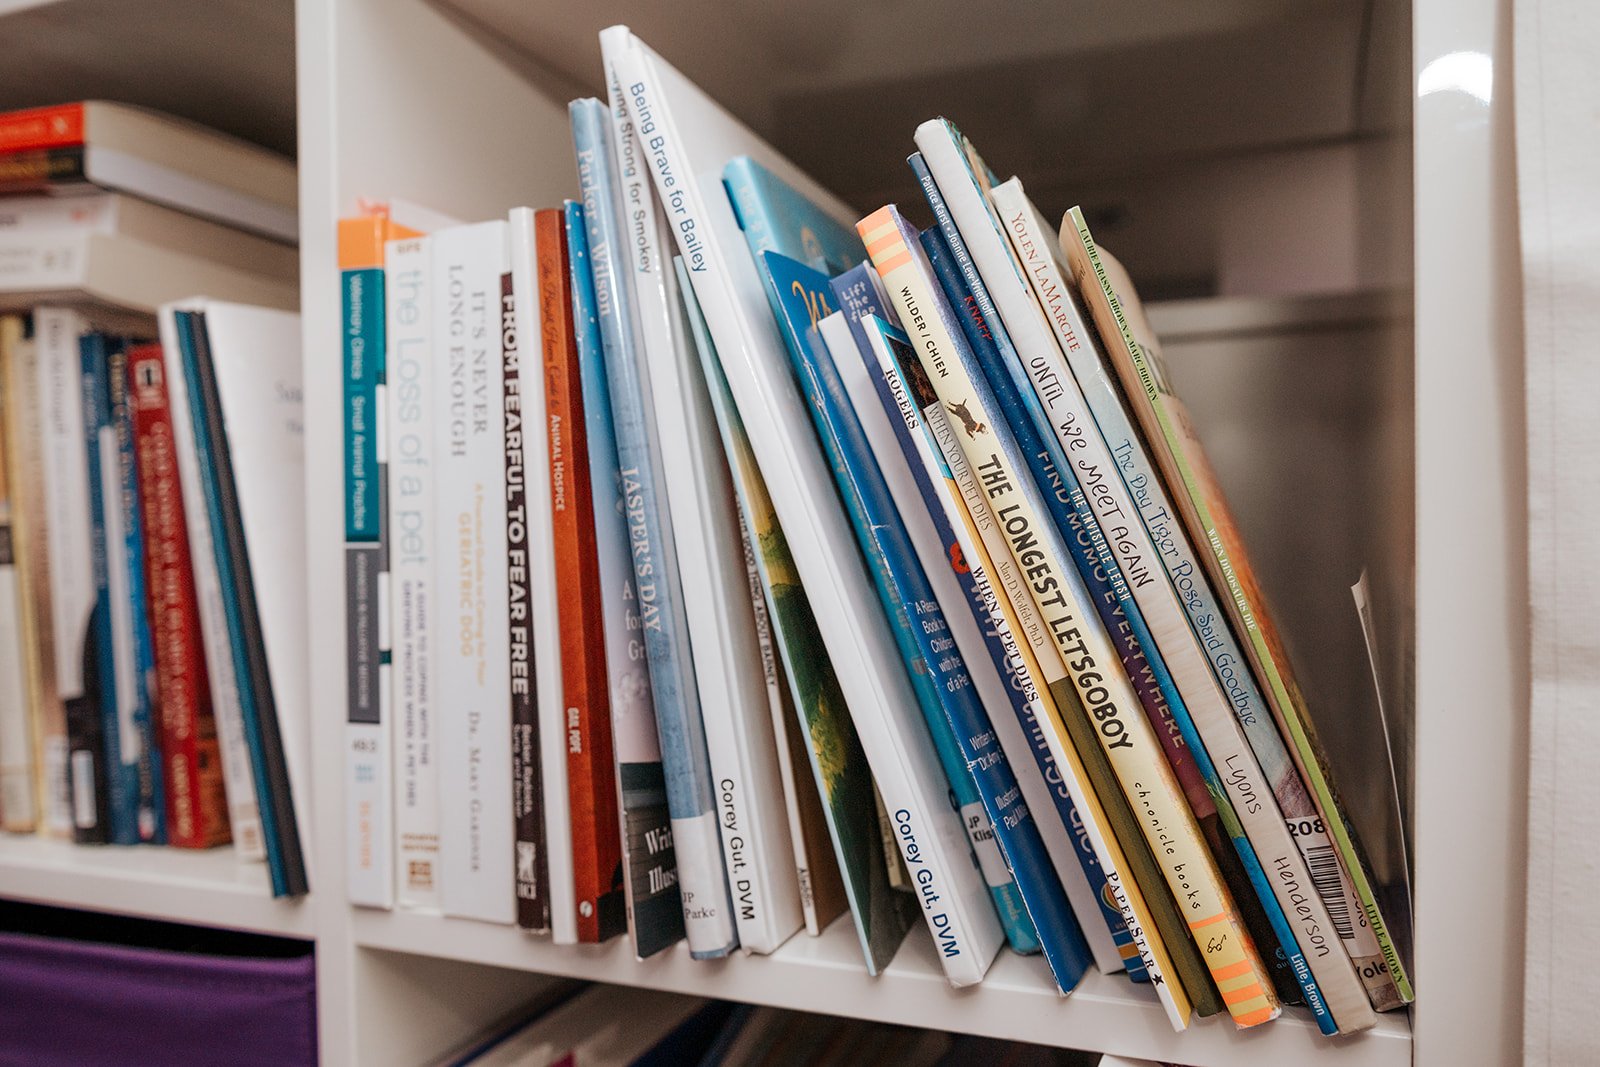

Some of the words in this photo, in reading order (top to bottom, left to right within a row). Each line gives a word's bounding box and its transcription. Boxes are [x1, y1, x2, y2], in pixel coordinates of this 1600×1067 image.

[620, 122, 636, 178] Strong
[630, 82, 656, 135] Being
[650, 135, 675, 188] Brave
[669, 190, 686, 215] for
[680, 219, 707, 272] Bailey
[629, 182, 642, 205] for
[578, 149, 598, 221] Parker
[591, 242, 611, 316] Wilson
[633, 211, 652, 274] Smokey
[921, 176, 939, 206] Patrice
[933, 201, 950, 227] Karst
[948, 233, 967, 263] Joanne
[962, 260, 996, 317] Lew-Vriethoff
[396, 270, 423, 326] the
[448, 264, 465, 337] LONG
[842, 281, 866, 300] Lift
[849, 296, 868, 310] the
[1080, 229, 1099, 262] LAURIE
[1094, 261, 1115, 299] KRASNY
[1108, 297, 1128, 332] BROWN
[1128, 340, 1145, 367] MARC
[1140, 366, 1159, 402] BROWN
[502, 295, 519, 373] FROM
[900, 286, 926, 332] WILDER
[926, 340, 949, 379] CHIEN
[450, 344, 466, 457] ENOUGH
[472, 348, 488, 435] NEVER
[885, 369, 919, 430] ROGERS
[398, 433, 428, 467] of
[504, 380, 525, 502] FEARFUL
[551, 414, 562, 459] ANIMAL
[928, 406, 952, 445] WHEN
[946, 444, 969, 482] YOUR
[963, 480, 979, 503] PET
[972, 504, 991, 532] DIES
[400, 475, 422, 496] a
[554, 461, 565, 512] HOSPICE
[399, 511, 427, 565] pet
[507, 507, 525, 543] TO
[1070, 487, 1087, 509] THE
[1081, 511, 1113, 564] INVISIBLE
[1107, 567, 1132, 602] LEASH
[458, 512, 472, 609] GERIATRIC
[508, 553, 526, 621] FEAR
[622, 580, 633, 600] A
[1000, 560, 1012, 580] Alan
[1011, 591, 1031, 625] Wolfelt,
[1115, 438, 1134, 472] The
[1129, 474, 1152, 509] Day
[1147, 506, 1178, 557] Tiger
[1172, 560, 1203, 612] Rose
[1196, 613, 1225, 651] Said
[1216, 652, 1257, 727] Goodbye
[1207, 527, 1222, 557] WHEN
[1219, 557, 1251, 615] DINOSAURS
[1245, 613, 1257, 632] DIE
[639, 583, 662, 632] DAY
[756, 605, 769, 639] ABOUT
[973, 566, 999, 613] WHEN
[993, 616, 1005, 627] A
[1000, 630, 1021, 662] PET
[1014, 662, 1039, 703] DIES
[978, 454, 1012, 499] THE
[997, 504, 1068, 608] LONGEST
[1049, 615, 1133, 750] LETSGOBOY
[1037, 451, 1071, 504] FIND
[1066, 512, 1108, 582] MOMO
[1104, 592, 1185, 748] EVERYWHERE
[460, 613, 473, 657] DOG
[720, 778, 738, 832] Corey
[730, 836, 744, 875] Gut,
[737, 880, 755, 921] DVM
[969, 816, 980, 829] JP
[1134, 782, 1175, 855] chronicle
[1174, 864, 1201, 910] books
[1225, 754, 1262, 815] Lyons
[1273, 856, 1330, 958] Henderson
[895, 809, 923, 864] Corey
[917, 869, 940, 910] Gut,
[932, 913, 960, 958] DVM
[1291, 953, 1308, 983] Little,
[1304, 983, 1325, 1017] Brown
[1381, 944, 1404, 984] BROWN
